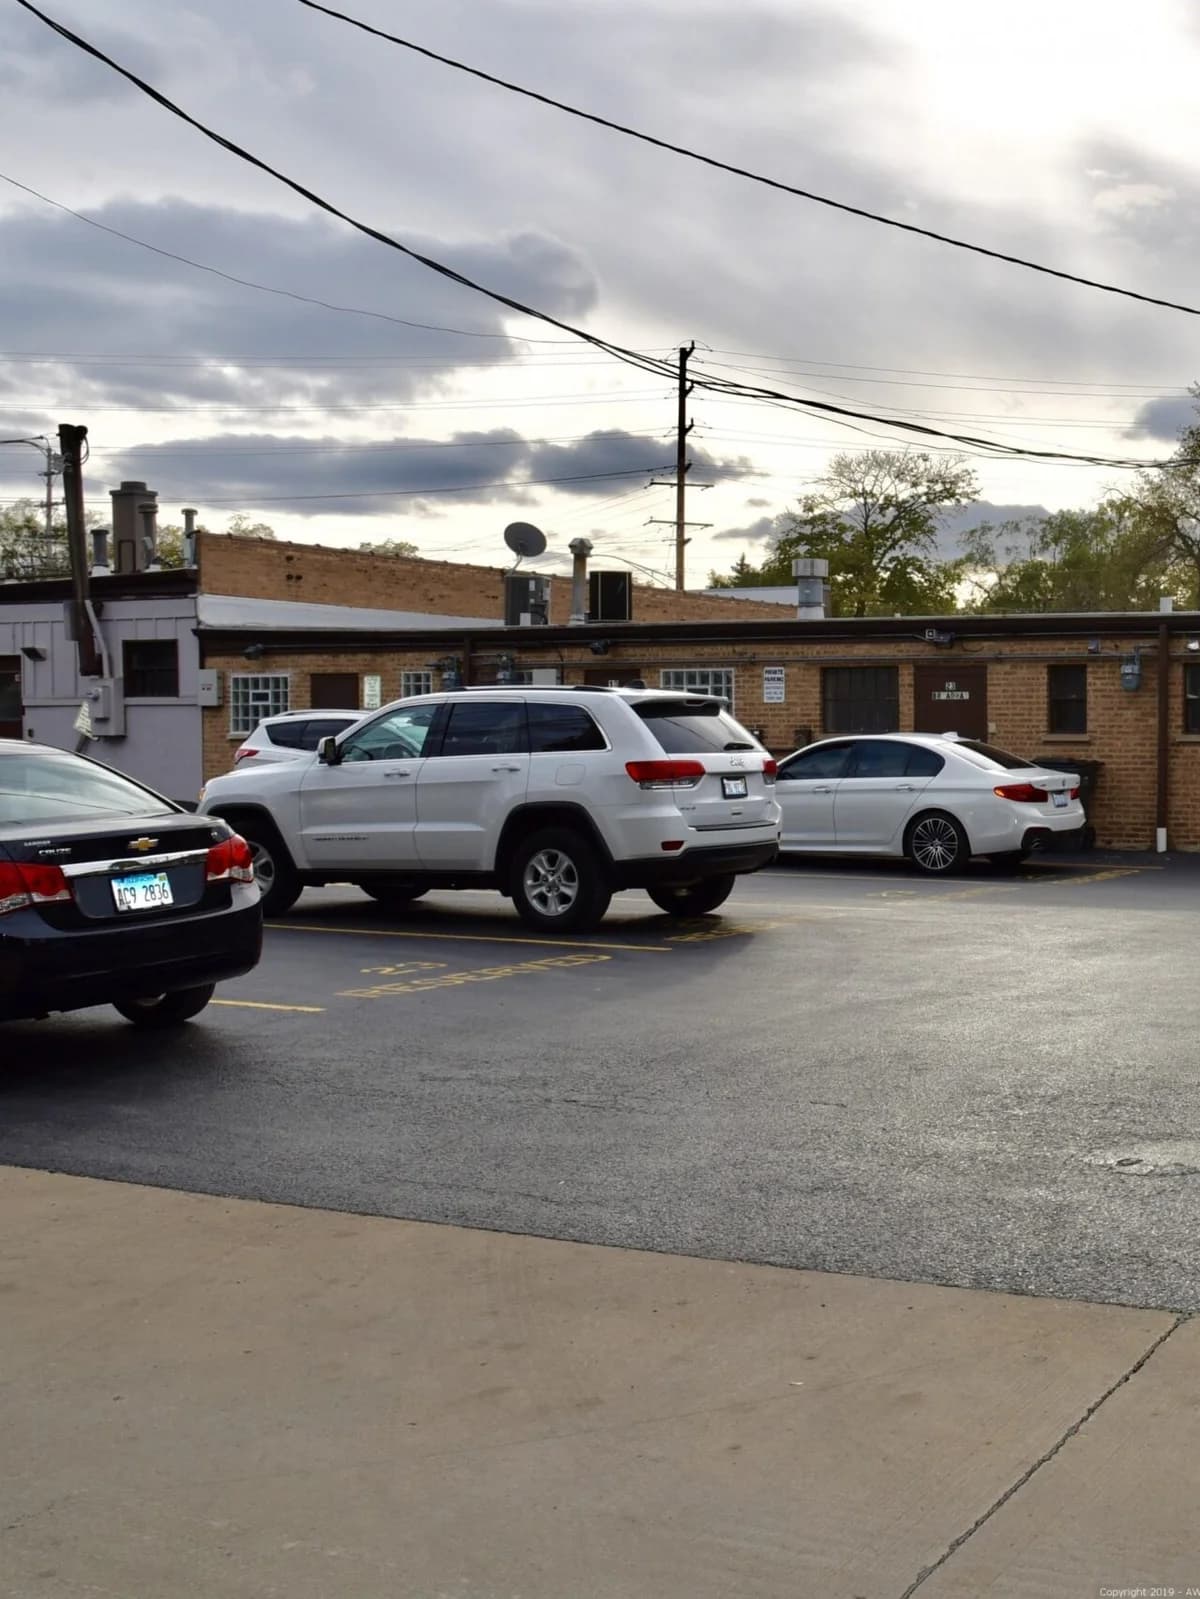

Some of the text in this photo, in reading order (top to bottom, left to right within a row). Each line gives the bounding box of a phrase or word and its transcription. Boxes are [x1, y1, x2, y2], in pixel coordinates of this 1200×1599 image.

[117, 882, 169, 905] AC9 2836
[333, 954, 612, 999] RESERVED
